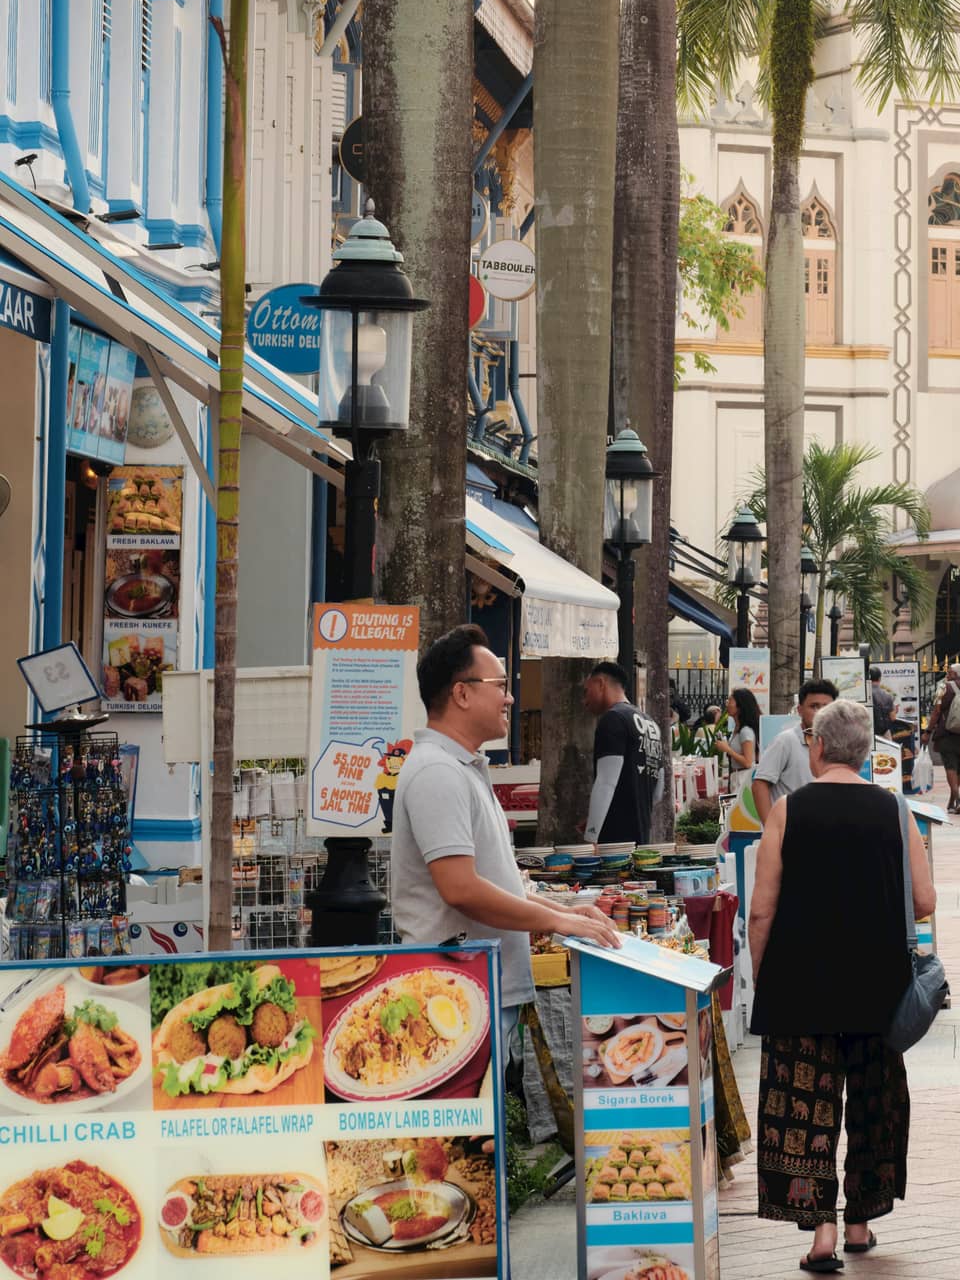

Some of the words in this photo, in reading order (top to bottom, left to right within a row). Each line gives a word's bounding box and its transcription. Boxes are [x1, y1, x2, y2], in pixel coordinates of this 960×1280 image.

[254, 298, 322, 331] Ottom
[252, 332, 295, 348] TURKISH
[112, 537, 137, 545] FRESH
[140, 537, 175, 545] BAKLAVA
[142, 621, 173, 629] KUNEFE
[352, 613, 399, 626] TOUTING
[402, 614, 414, 627] IS
[337, 766, 363, 781] FINE
[321, 786, 328, 799] 6
[330, 787, 373, 803] MONTHS
[320, 799, 343, 812] JAIL
[348, 801, 370, 815] TIME
[598, 1095, 637, 1107] Sigara
[640, 1093, 675, 1104] Borek
[161, 1119, 209, 1137] FALAFEL
[211, 1118, 228, 1136] OR
[230, 1116, 279, 1135] FALAFEL
[280, 1114, 314, 1133] WRAP
[339, 1111, 392, 1131] BOMBAY
[395, 1109, 430, 1129] LAMB
[433, 1107, 483, 1128] BIRYANI
[74, 1121, 136, 1141] CRAB
[613, 1209, 667, 1221] Baklava
